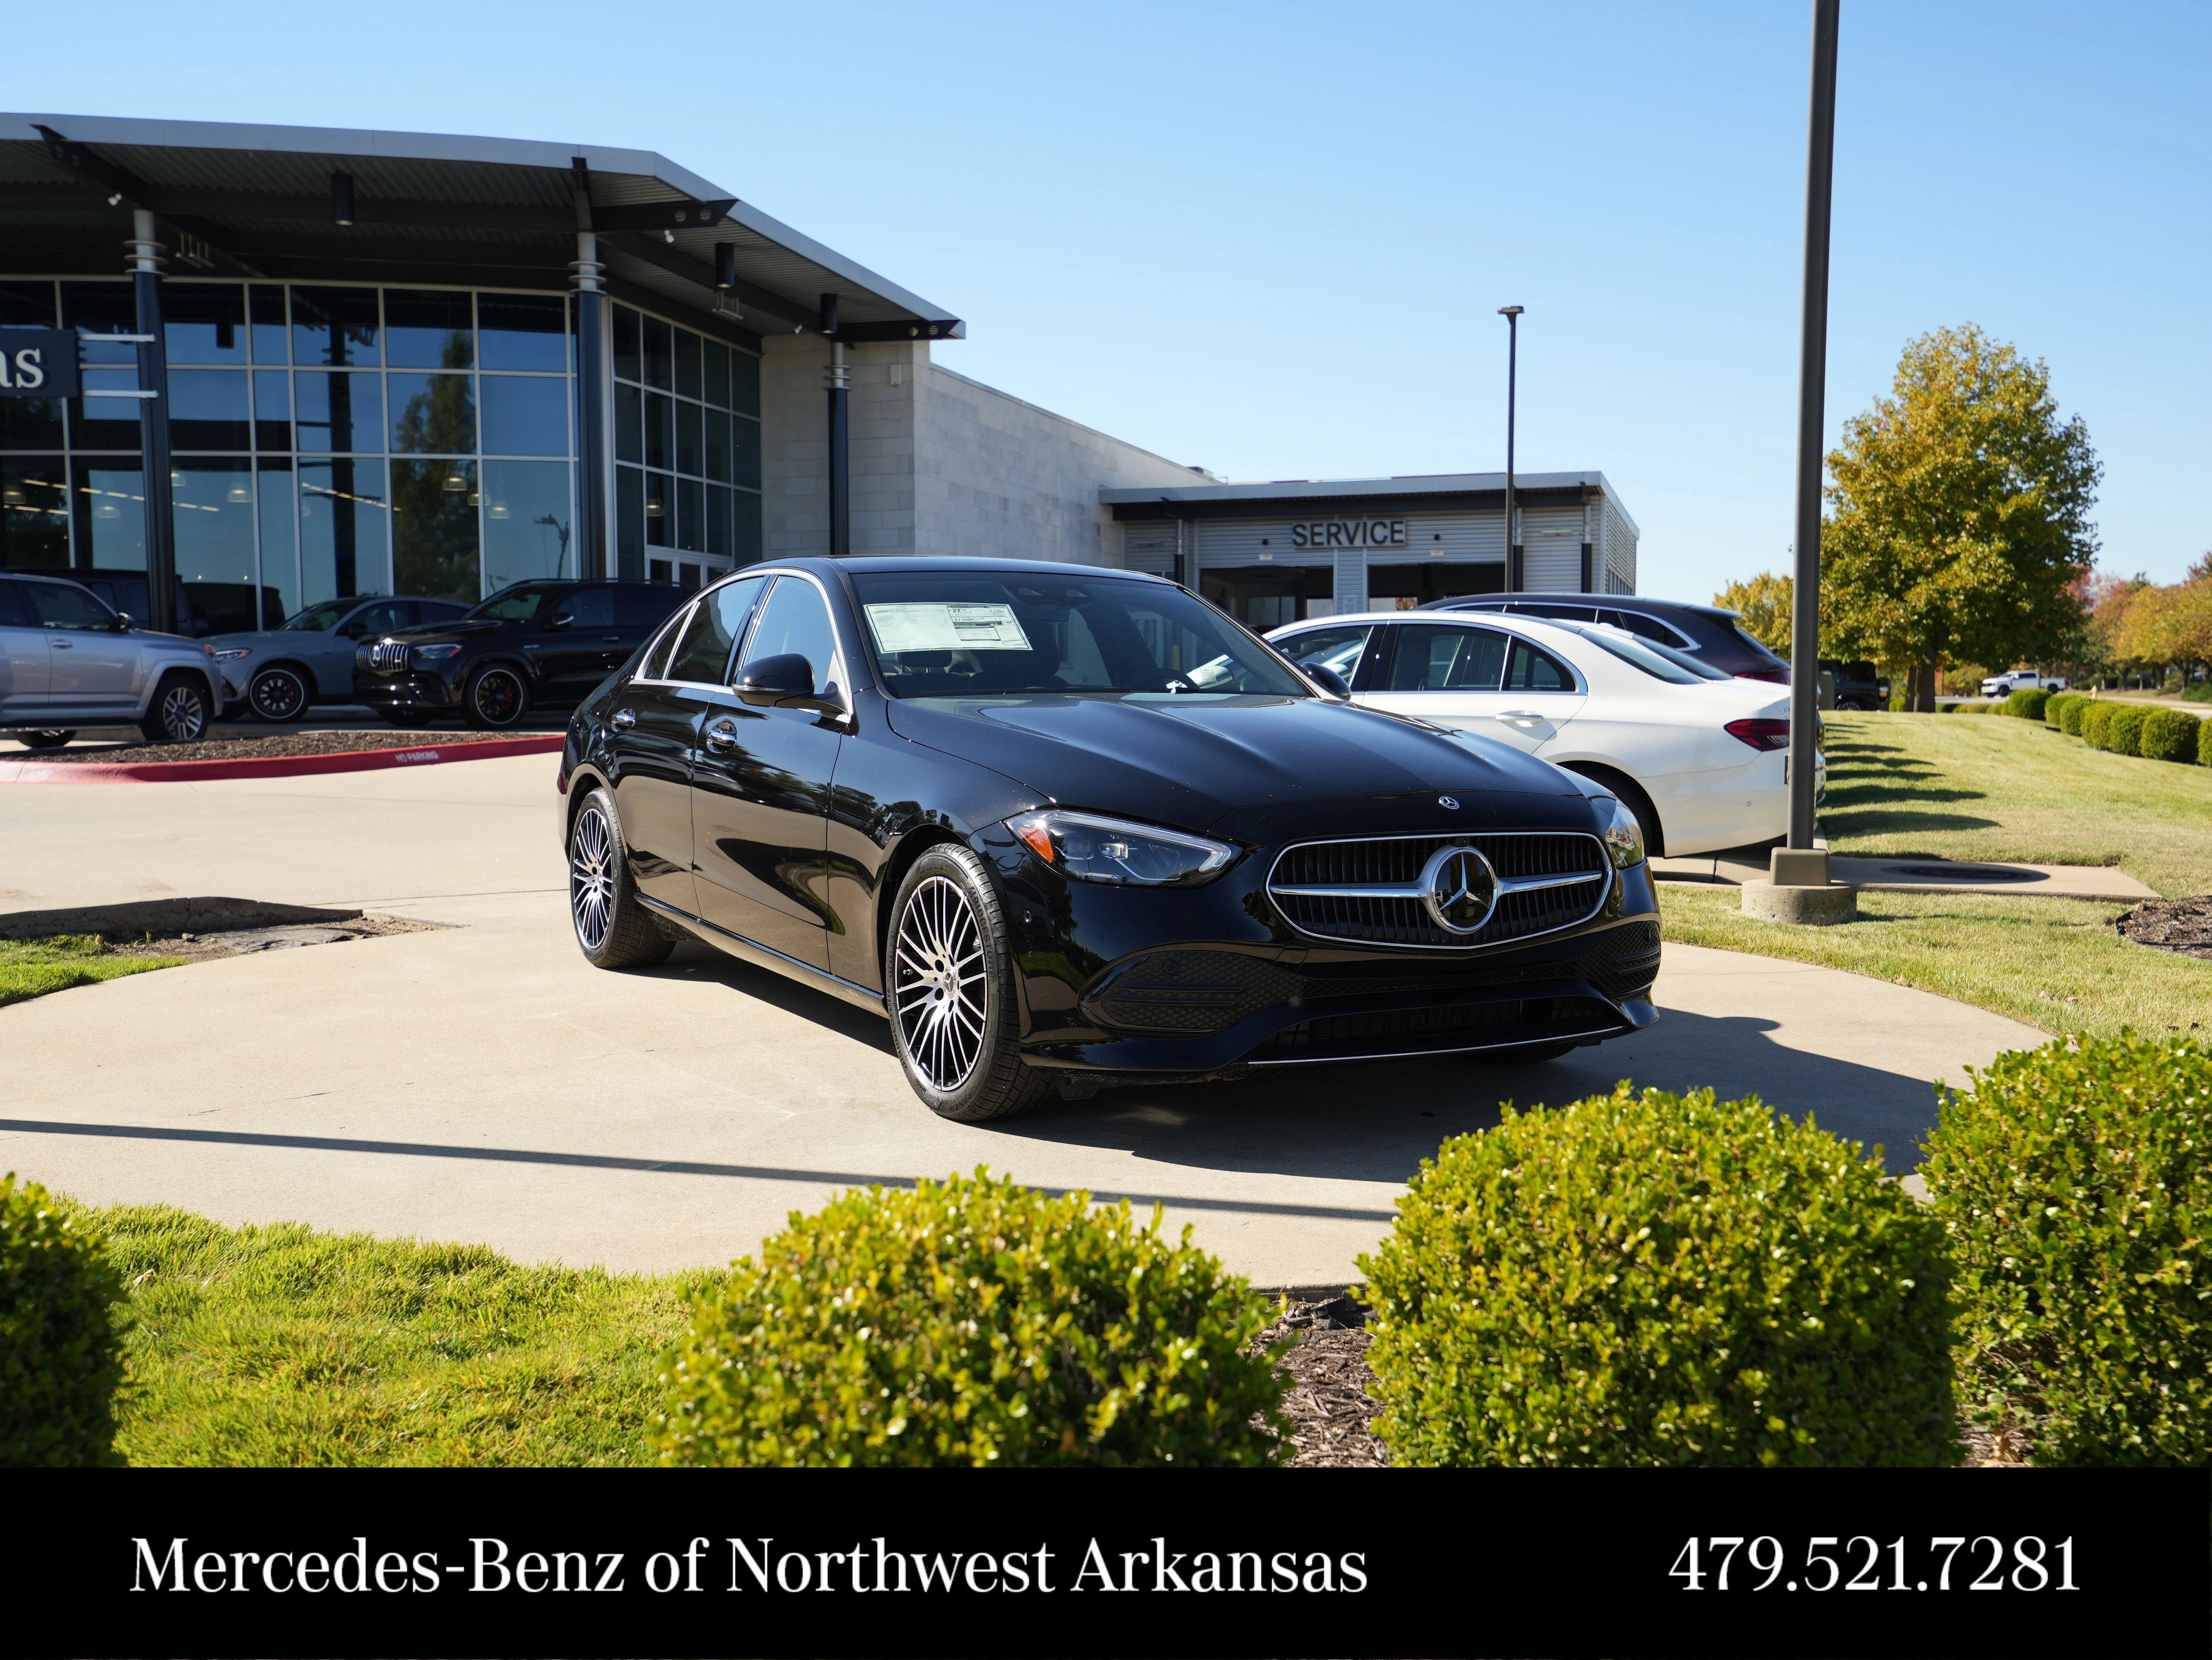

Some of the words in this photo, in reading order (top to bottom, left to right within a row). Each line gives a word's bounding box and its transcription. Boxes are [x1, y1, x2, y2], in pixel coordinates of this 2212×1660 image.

[1292, 520, 1404, 546] SERVICE
[394, 753, 407, 763] NO
[406, 750, 439, 762] PARKING
[968, 886, 995, 980] BRIDGESTONE
